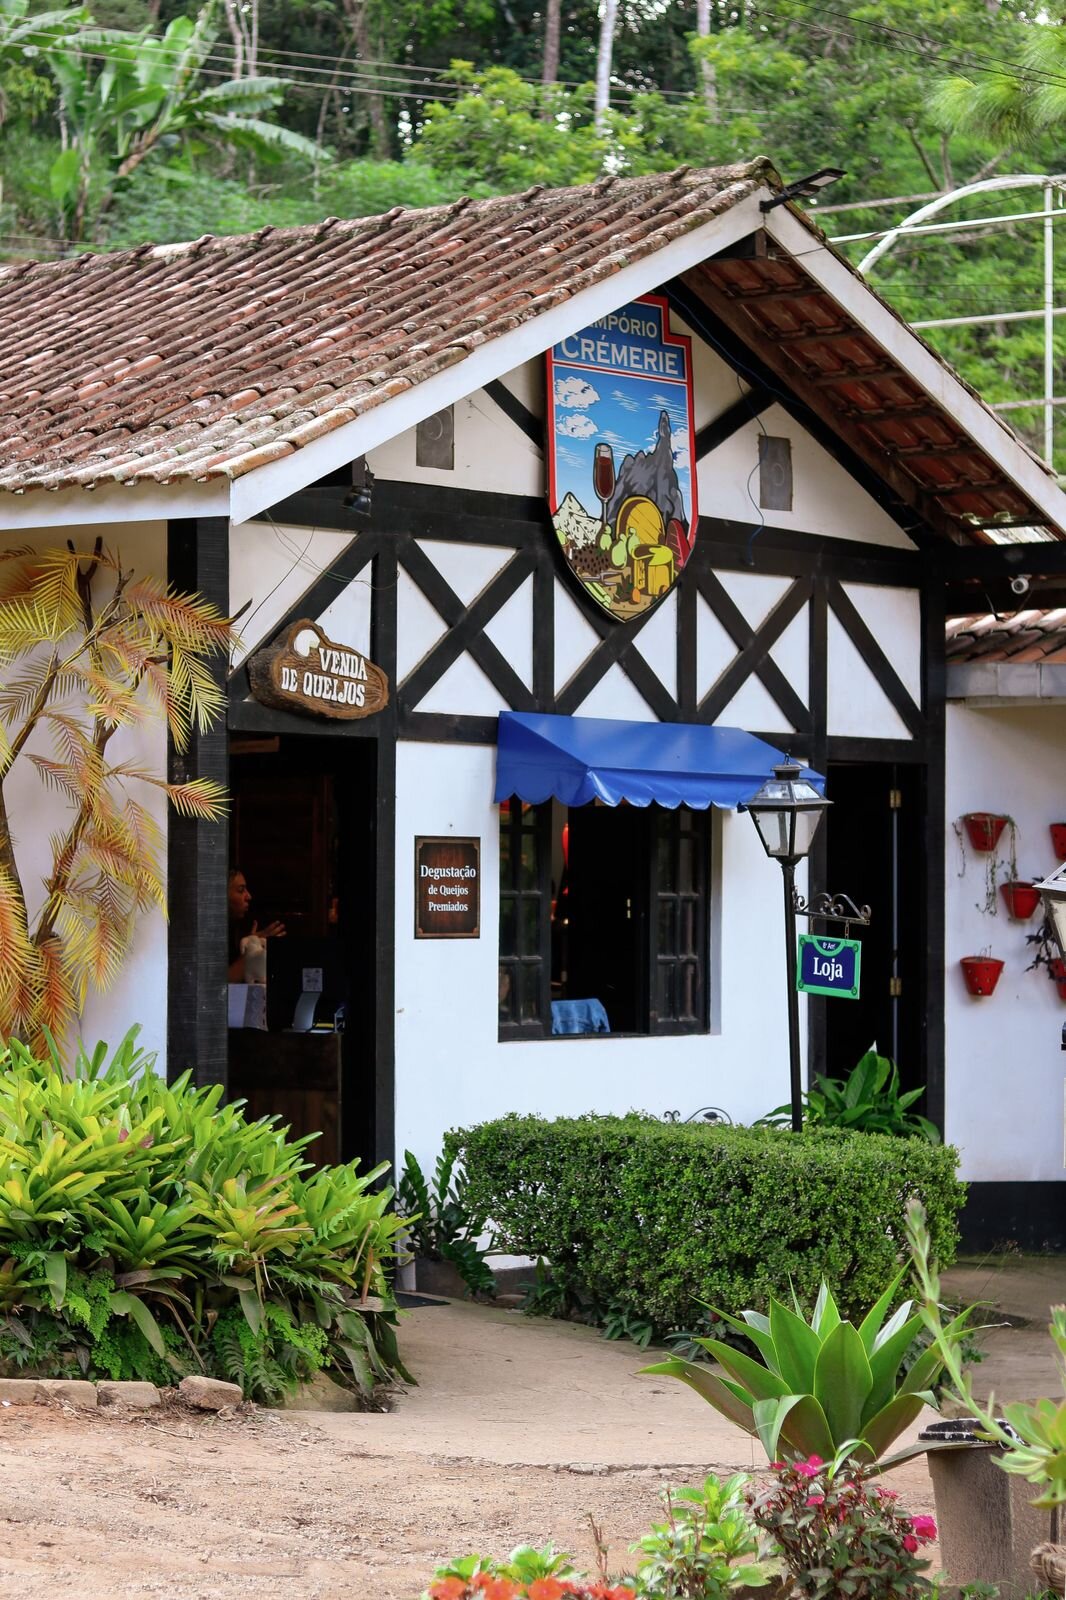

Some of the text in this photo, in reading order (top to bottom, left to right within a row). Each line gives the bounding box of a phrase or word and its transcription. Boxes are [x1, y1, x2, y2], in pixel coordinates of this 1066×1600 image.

[589, 312, 658, 339] MPÓRIO
[561, 334, 679, 375] CRÉMERIE
[319, 647, 368, 680] VENDA
[281, 667, 366, 707] DE QUEIJOS
[420, 864, 477, 880] Degustação
[428, 884, 469, 897] de Queijos
[428, 901, 469, 912] Premiados
[813, 957, 844, 981] Loja
